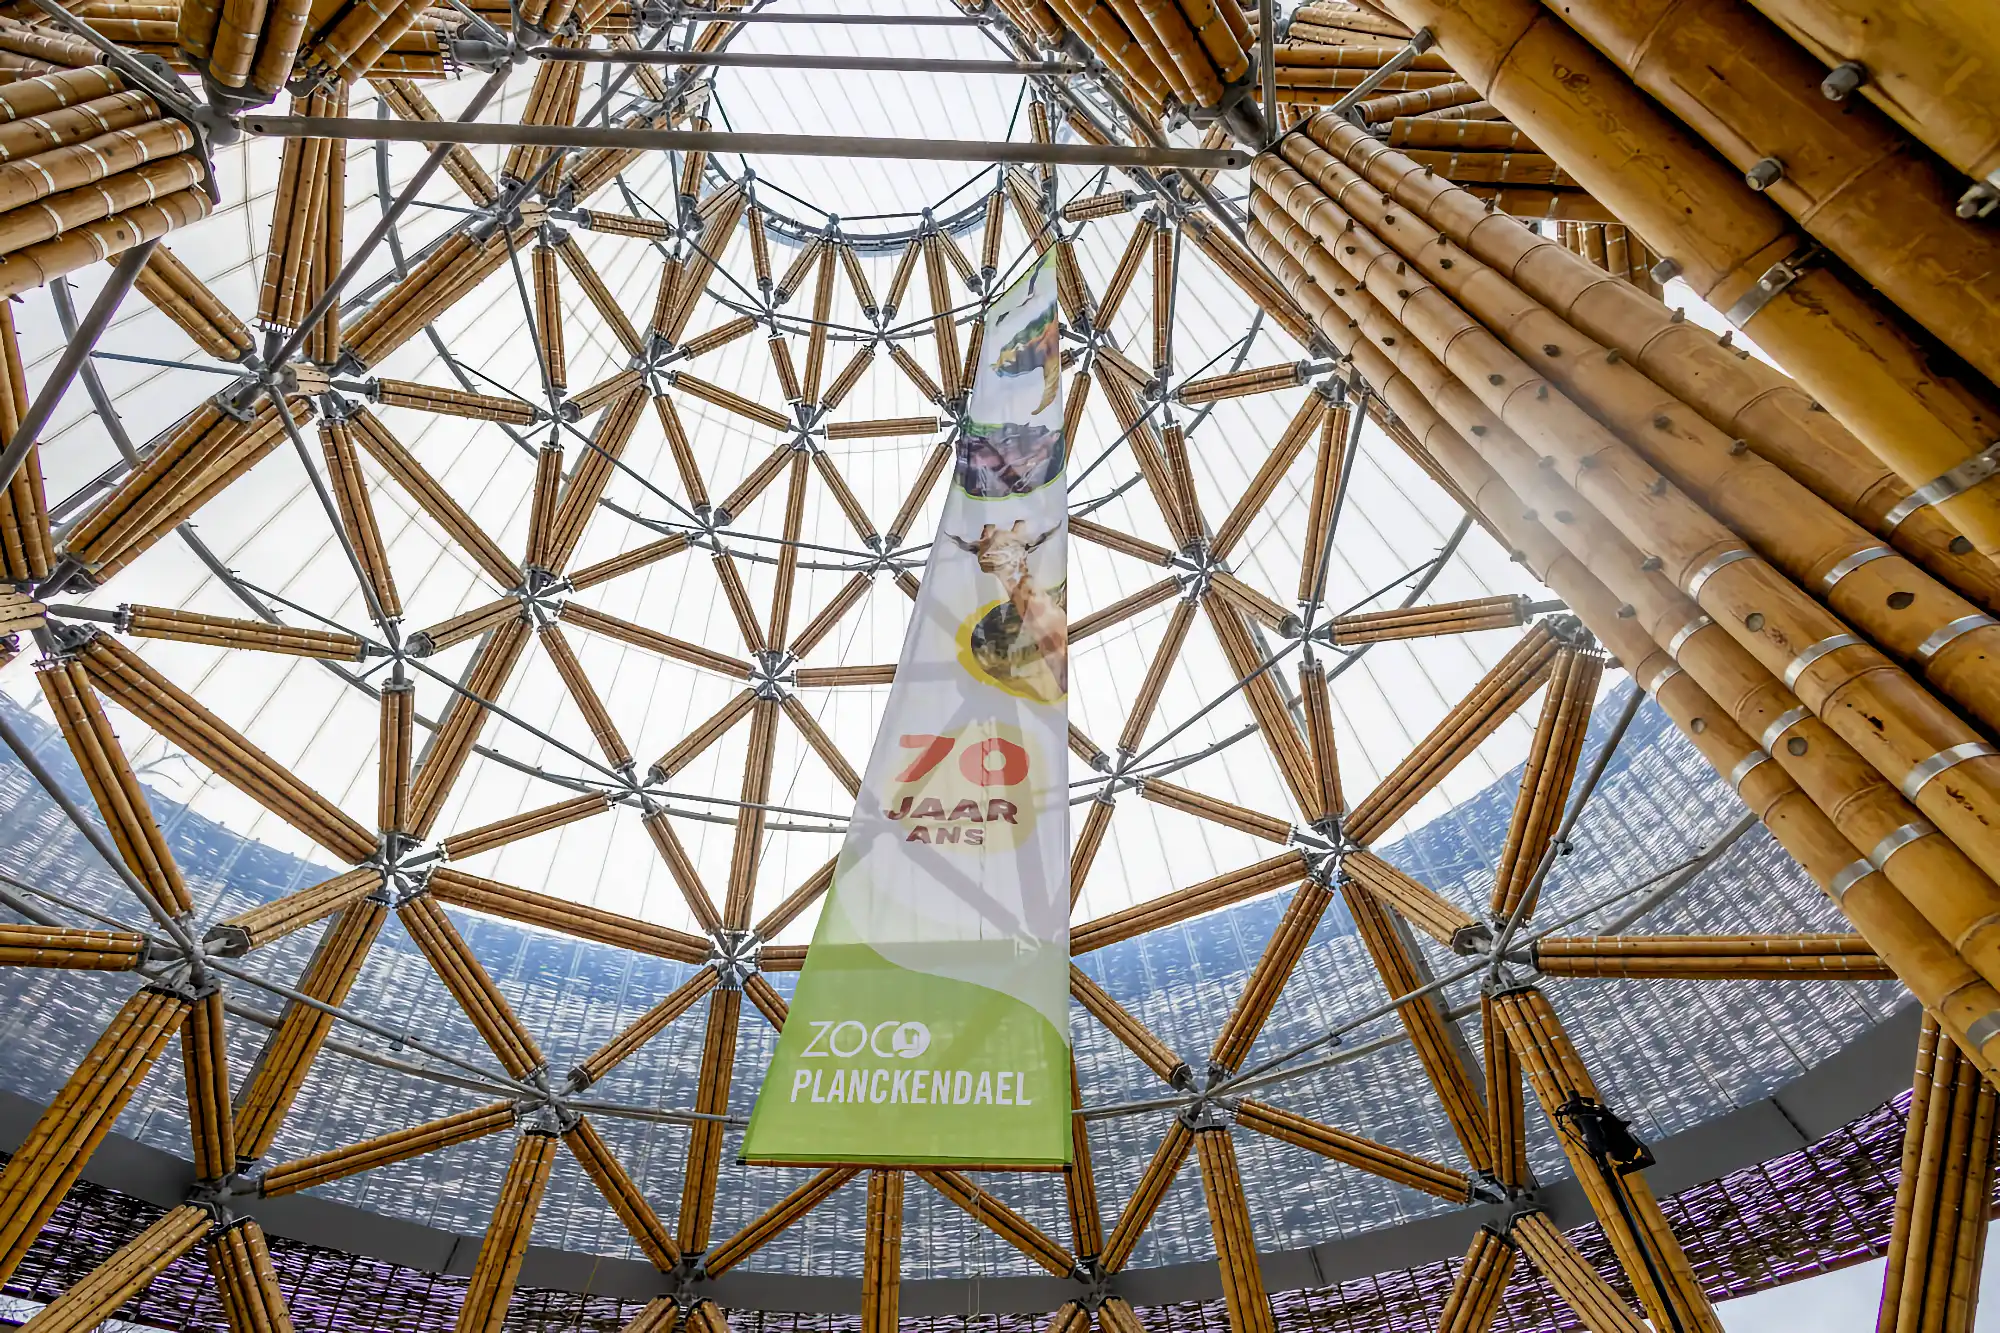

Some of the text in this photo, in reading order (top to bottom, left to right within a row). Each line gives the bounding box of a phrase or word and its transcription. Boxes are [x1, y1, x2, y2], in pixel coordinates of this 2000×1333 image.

[895, 734, 1030, 786] 70
[883, 796, 1018, 824] JAAR
[906, 825, 984, 845] ANS
[791, 1069, 1032, 1105] PLANCKENDAEL
